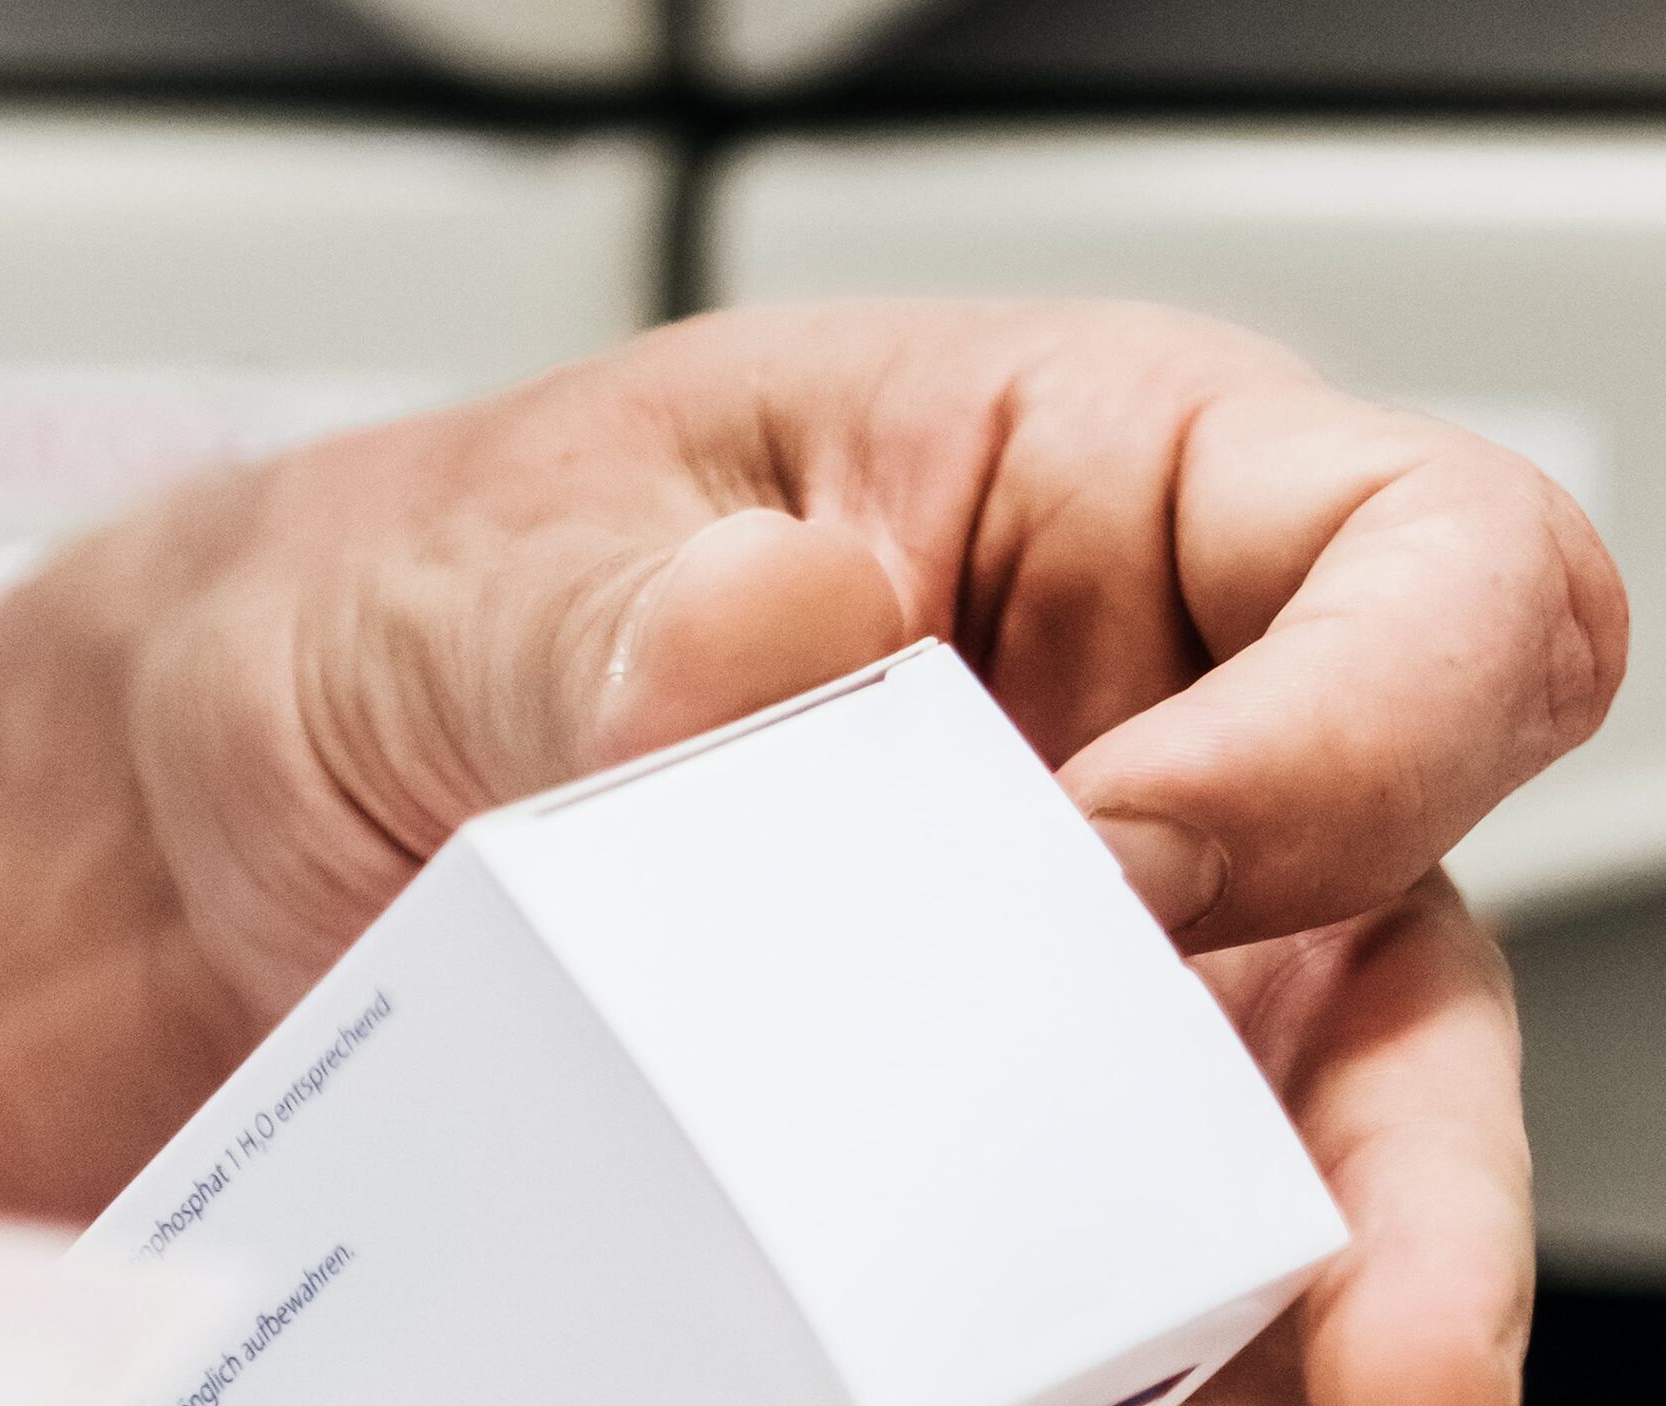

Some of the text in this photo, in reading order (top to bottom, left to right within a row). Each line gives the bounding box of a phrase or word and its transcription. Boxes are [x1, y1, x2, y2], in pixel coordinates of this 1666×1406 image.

[224, 1147, 242, 1171] 1
[274, 988, 392, 1123] entsprechend
[243, 1244, 355, 1362] aufbewahren.
